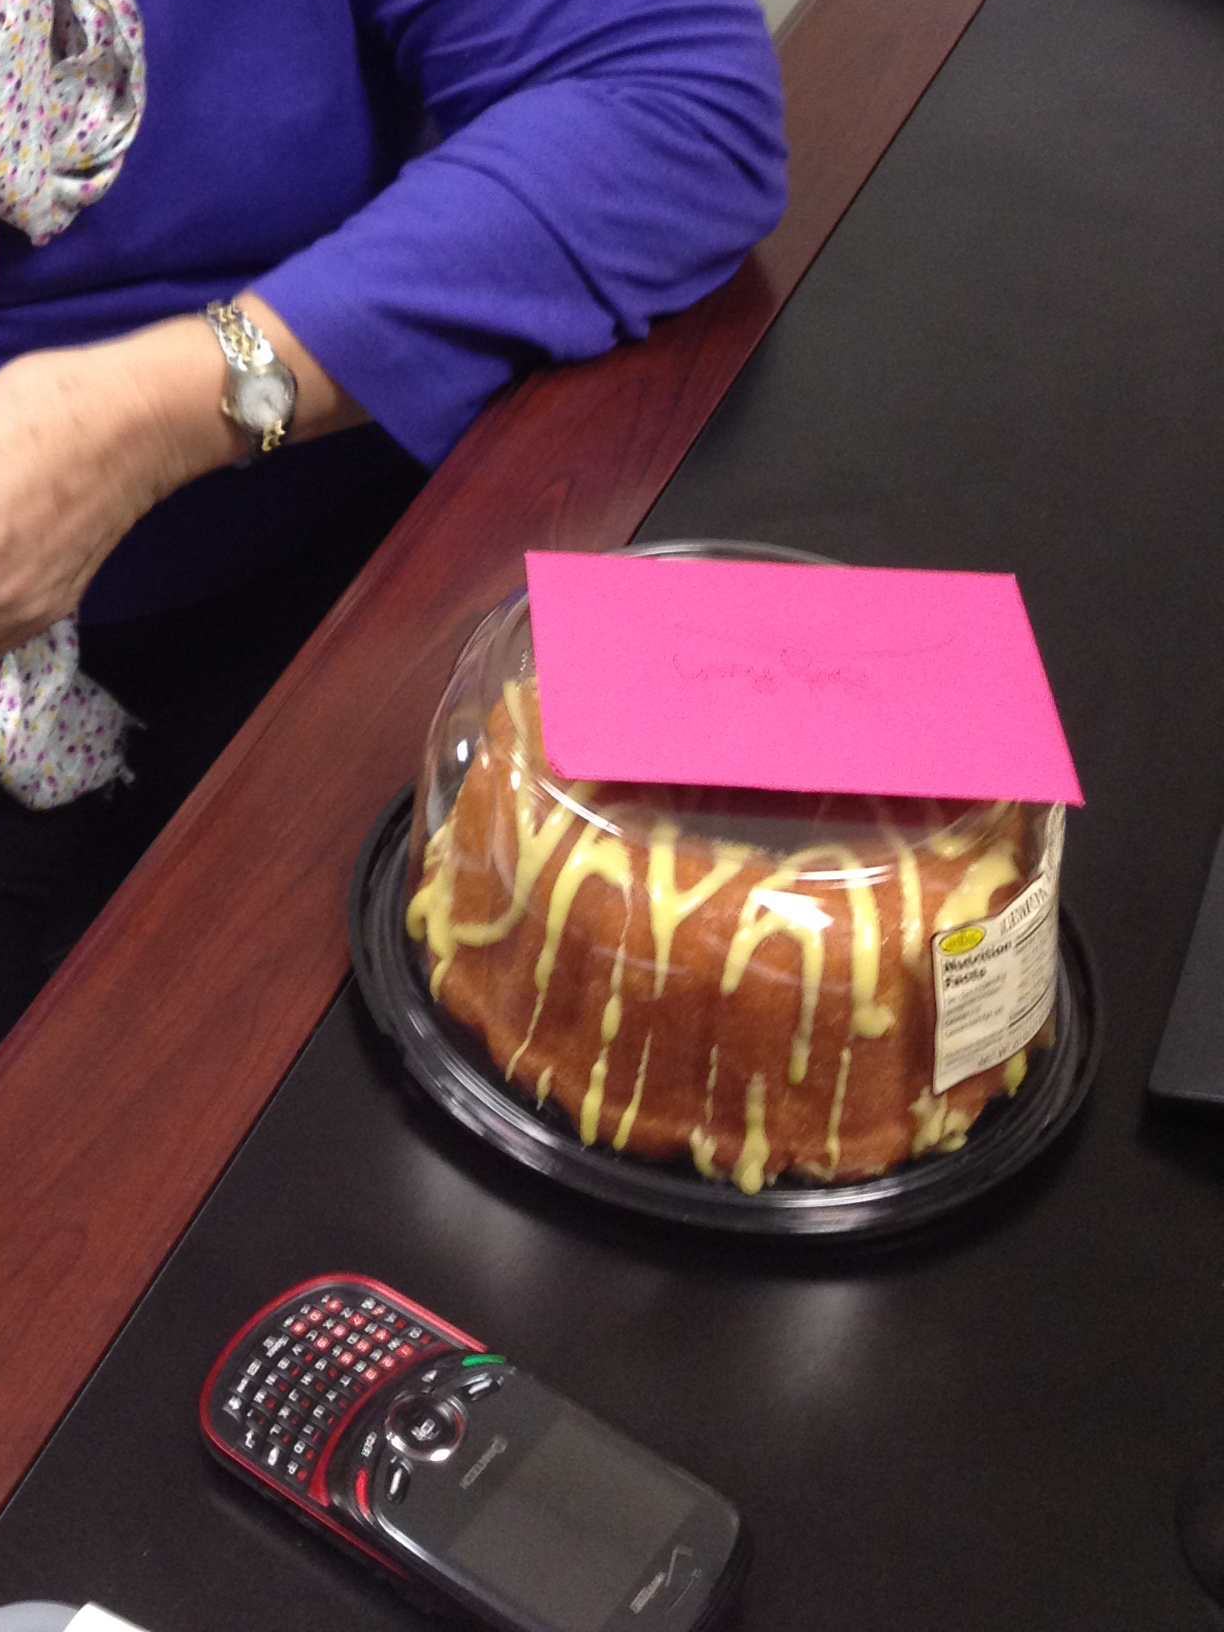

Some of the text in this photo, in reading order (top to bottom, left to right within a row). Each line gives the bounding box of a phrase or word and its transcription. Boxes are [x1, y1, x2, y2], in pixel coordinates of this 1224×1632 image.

[999, 886, 1049, 936] LEMON
[943, 940, 1012, 973] Nutrition
[944, 967, 988, 989] Facts
